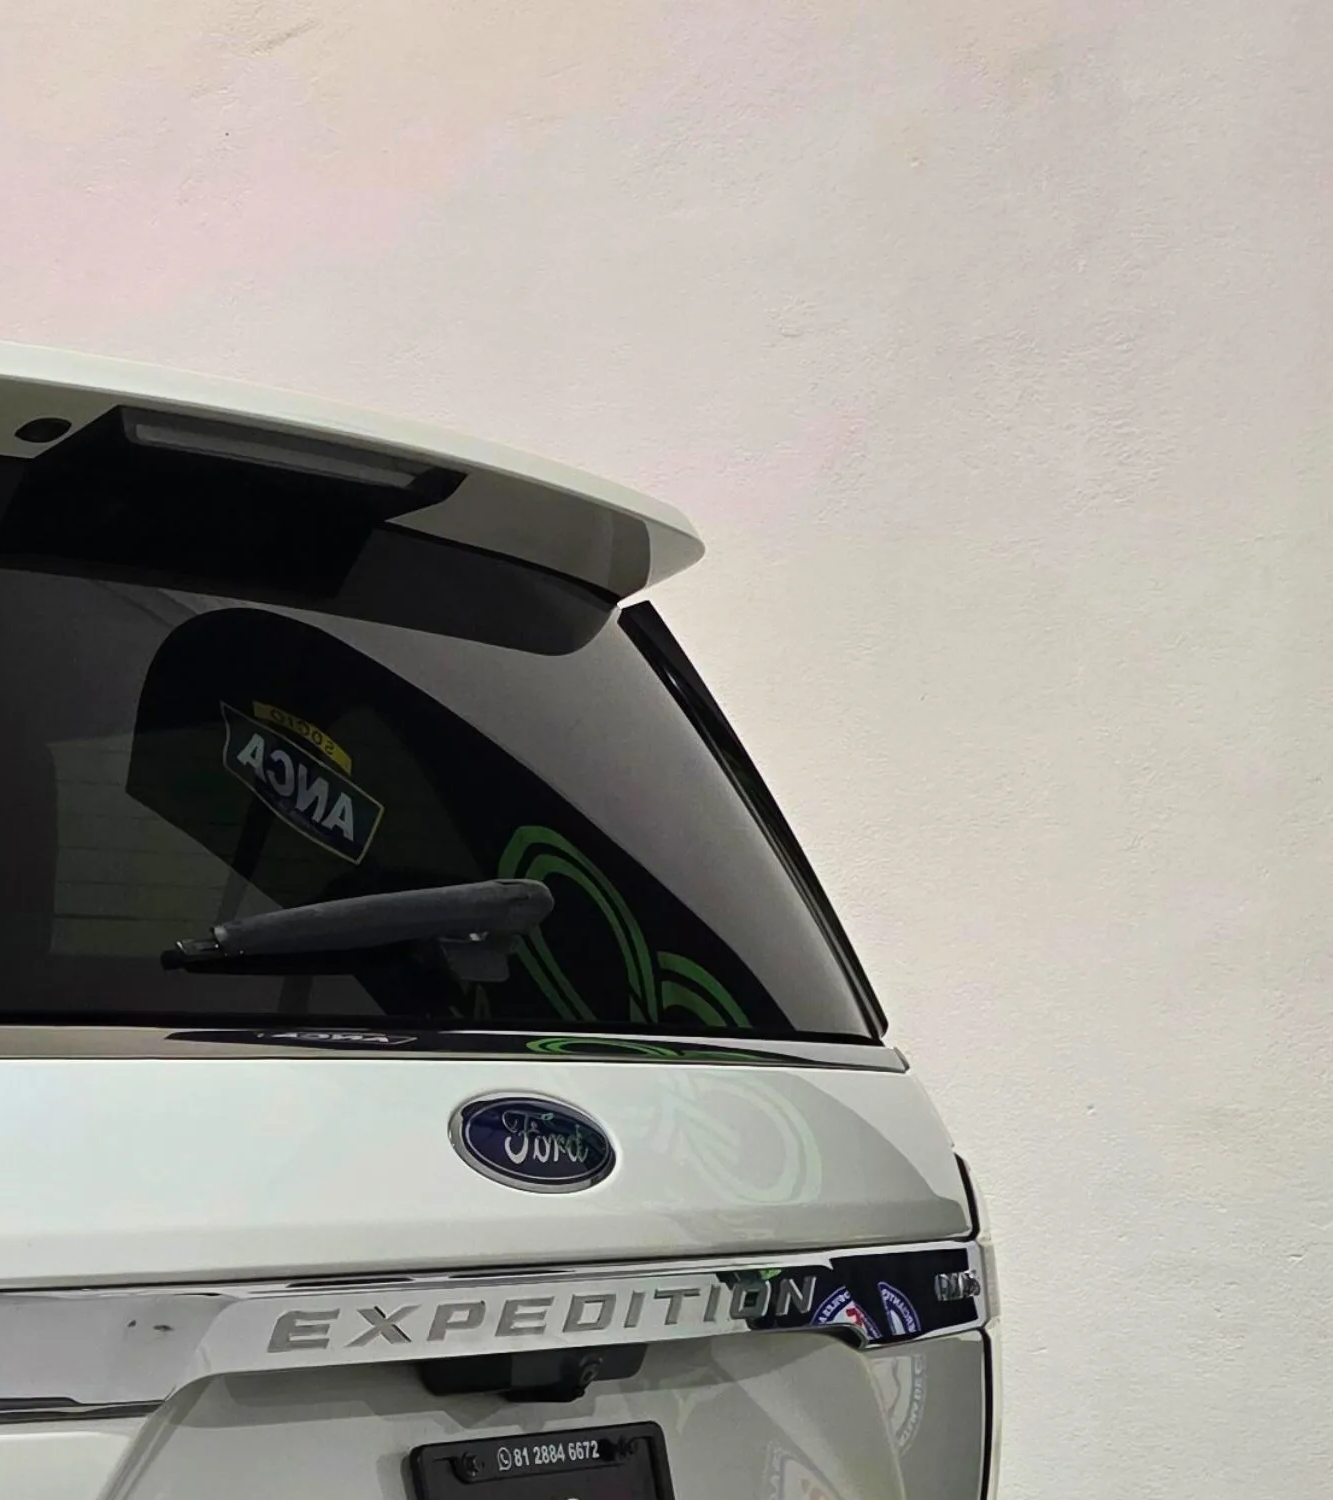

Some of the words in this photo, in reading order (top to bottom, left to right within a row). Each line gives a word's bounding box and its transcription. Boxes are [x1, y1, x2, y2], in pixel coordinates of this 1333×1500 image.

[501, 1109, 589, 1165] Ford
[266, 1274, 816, 1355] EXPEDITION
[513, 1447, 530, 1467] 81
[533, 1442, 565, 1465] 2884
[568, 1440, 600, 1461] 6672
